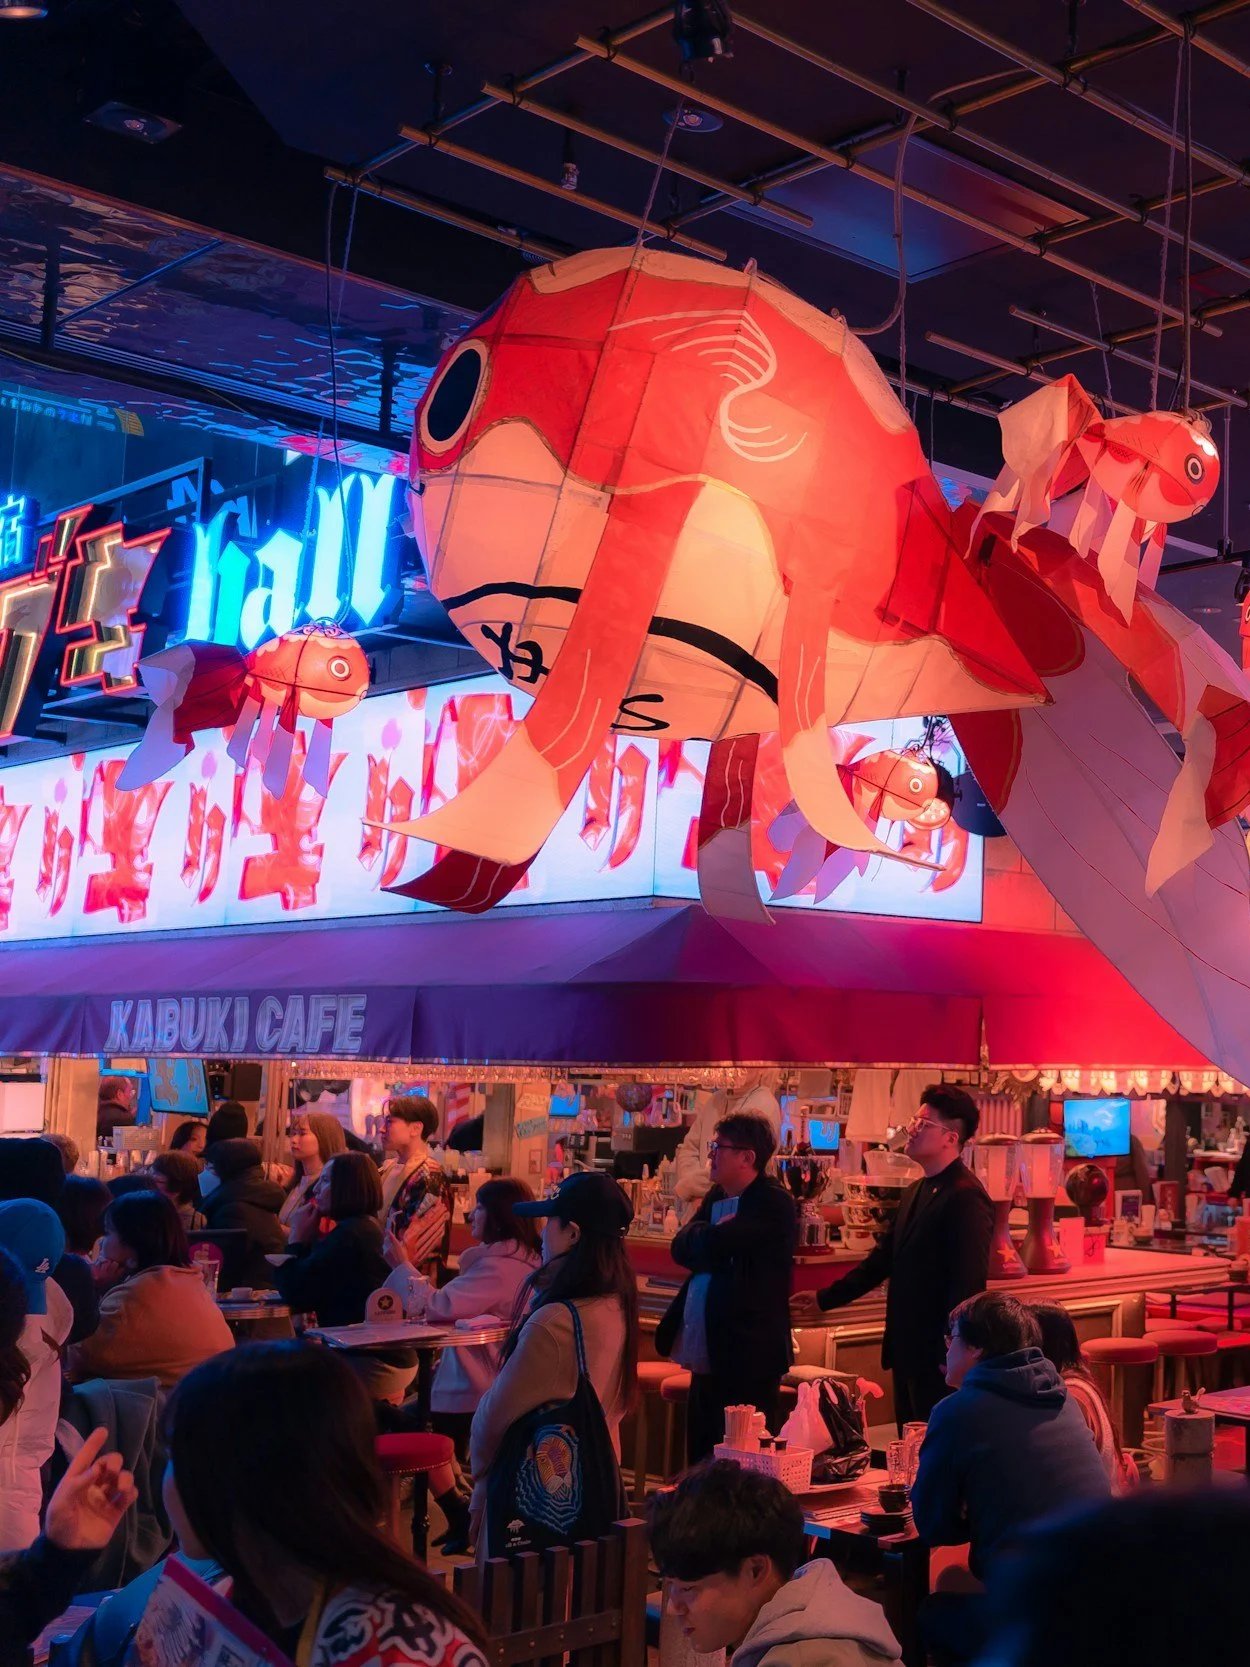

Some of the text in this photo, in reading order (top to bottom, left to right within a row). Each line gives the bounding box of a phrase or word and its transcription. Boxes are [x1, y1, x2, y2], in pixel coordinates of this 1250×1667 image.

[184, 471, 403, 652] hall
[103, 993, 367, 1053] KABUKI CAFE
